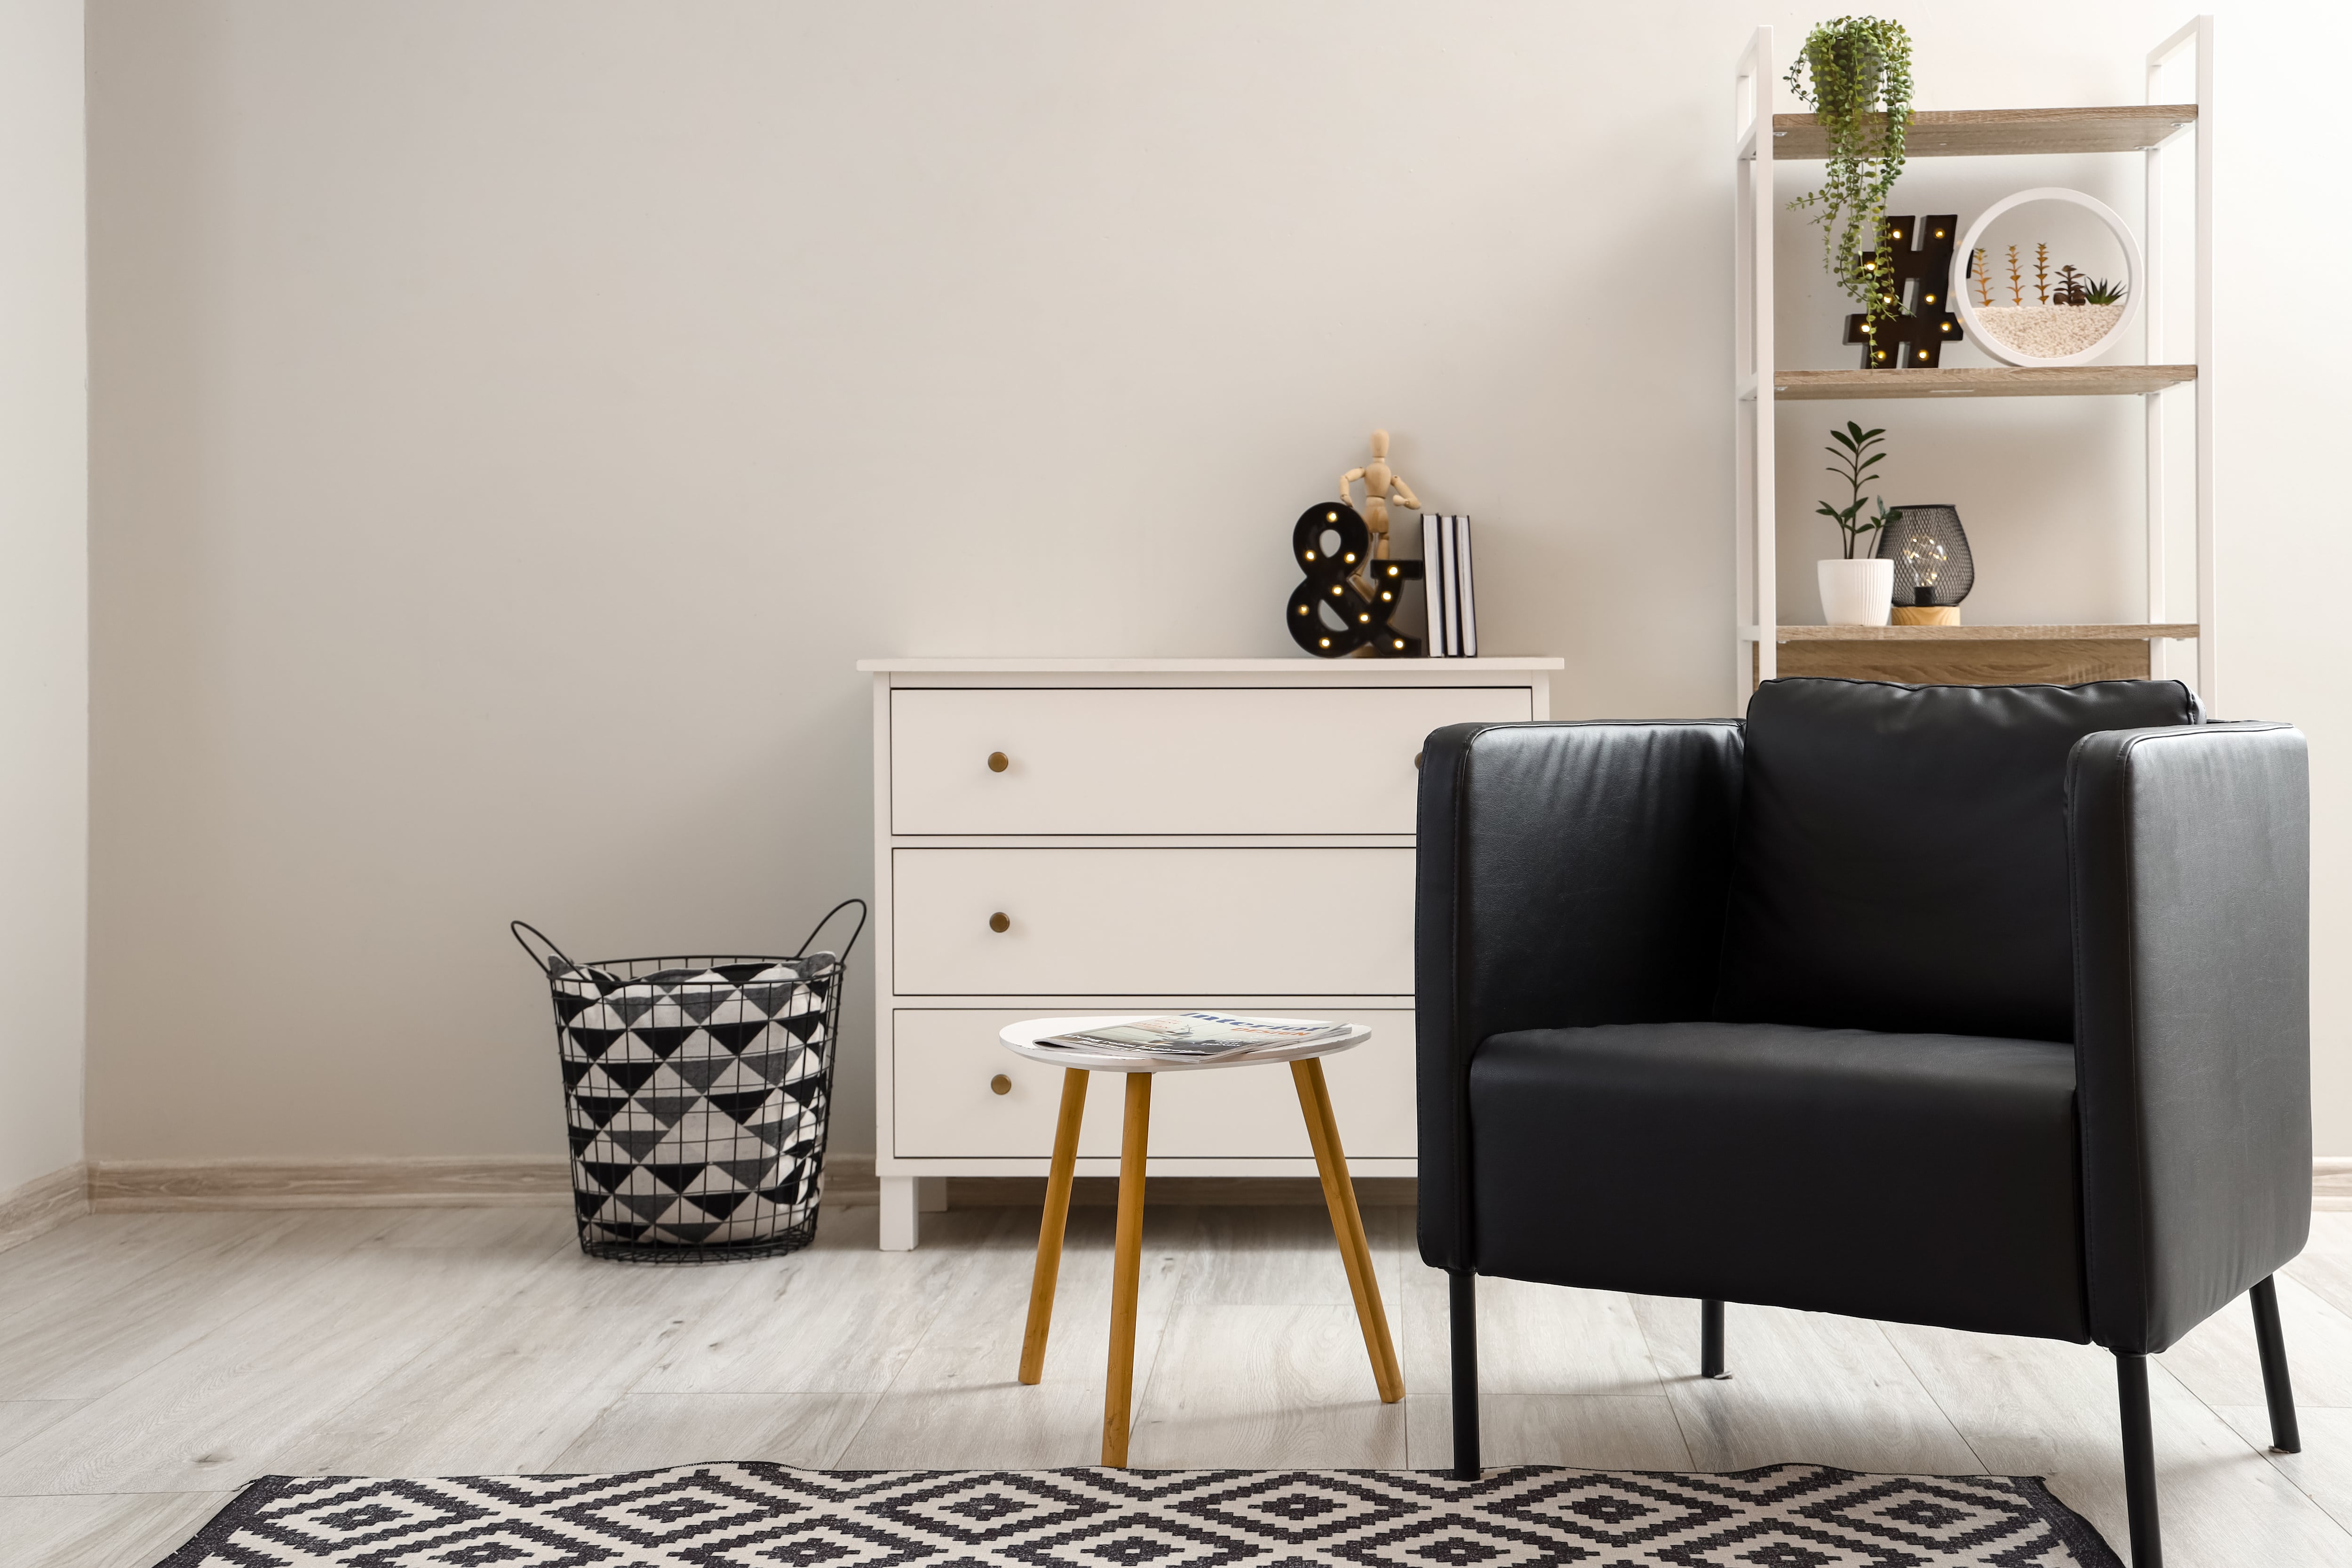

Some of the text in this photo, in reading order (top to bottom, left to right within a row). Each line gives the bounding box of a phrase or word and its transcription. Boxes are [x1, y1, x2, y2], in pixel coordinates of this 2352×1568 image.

[1287, 501, 1423, 658] &
[1178, 1012, 1330, 1031] Interior
[1230, 1027, 1311, 1036] DESIGN
